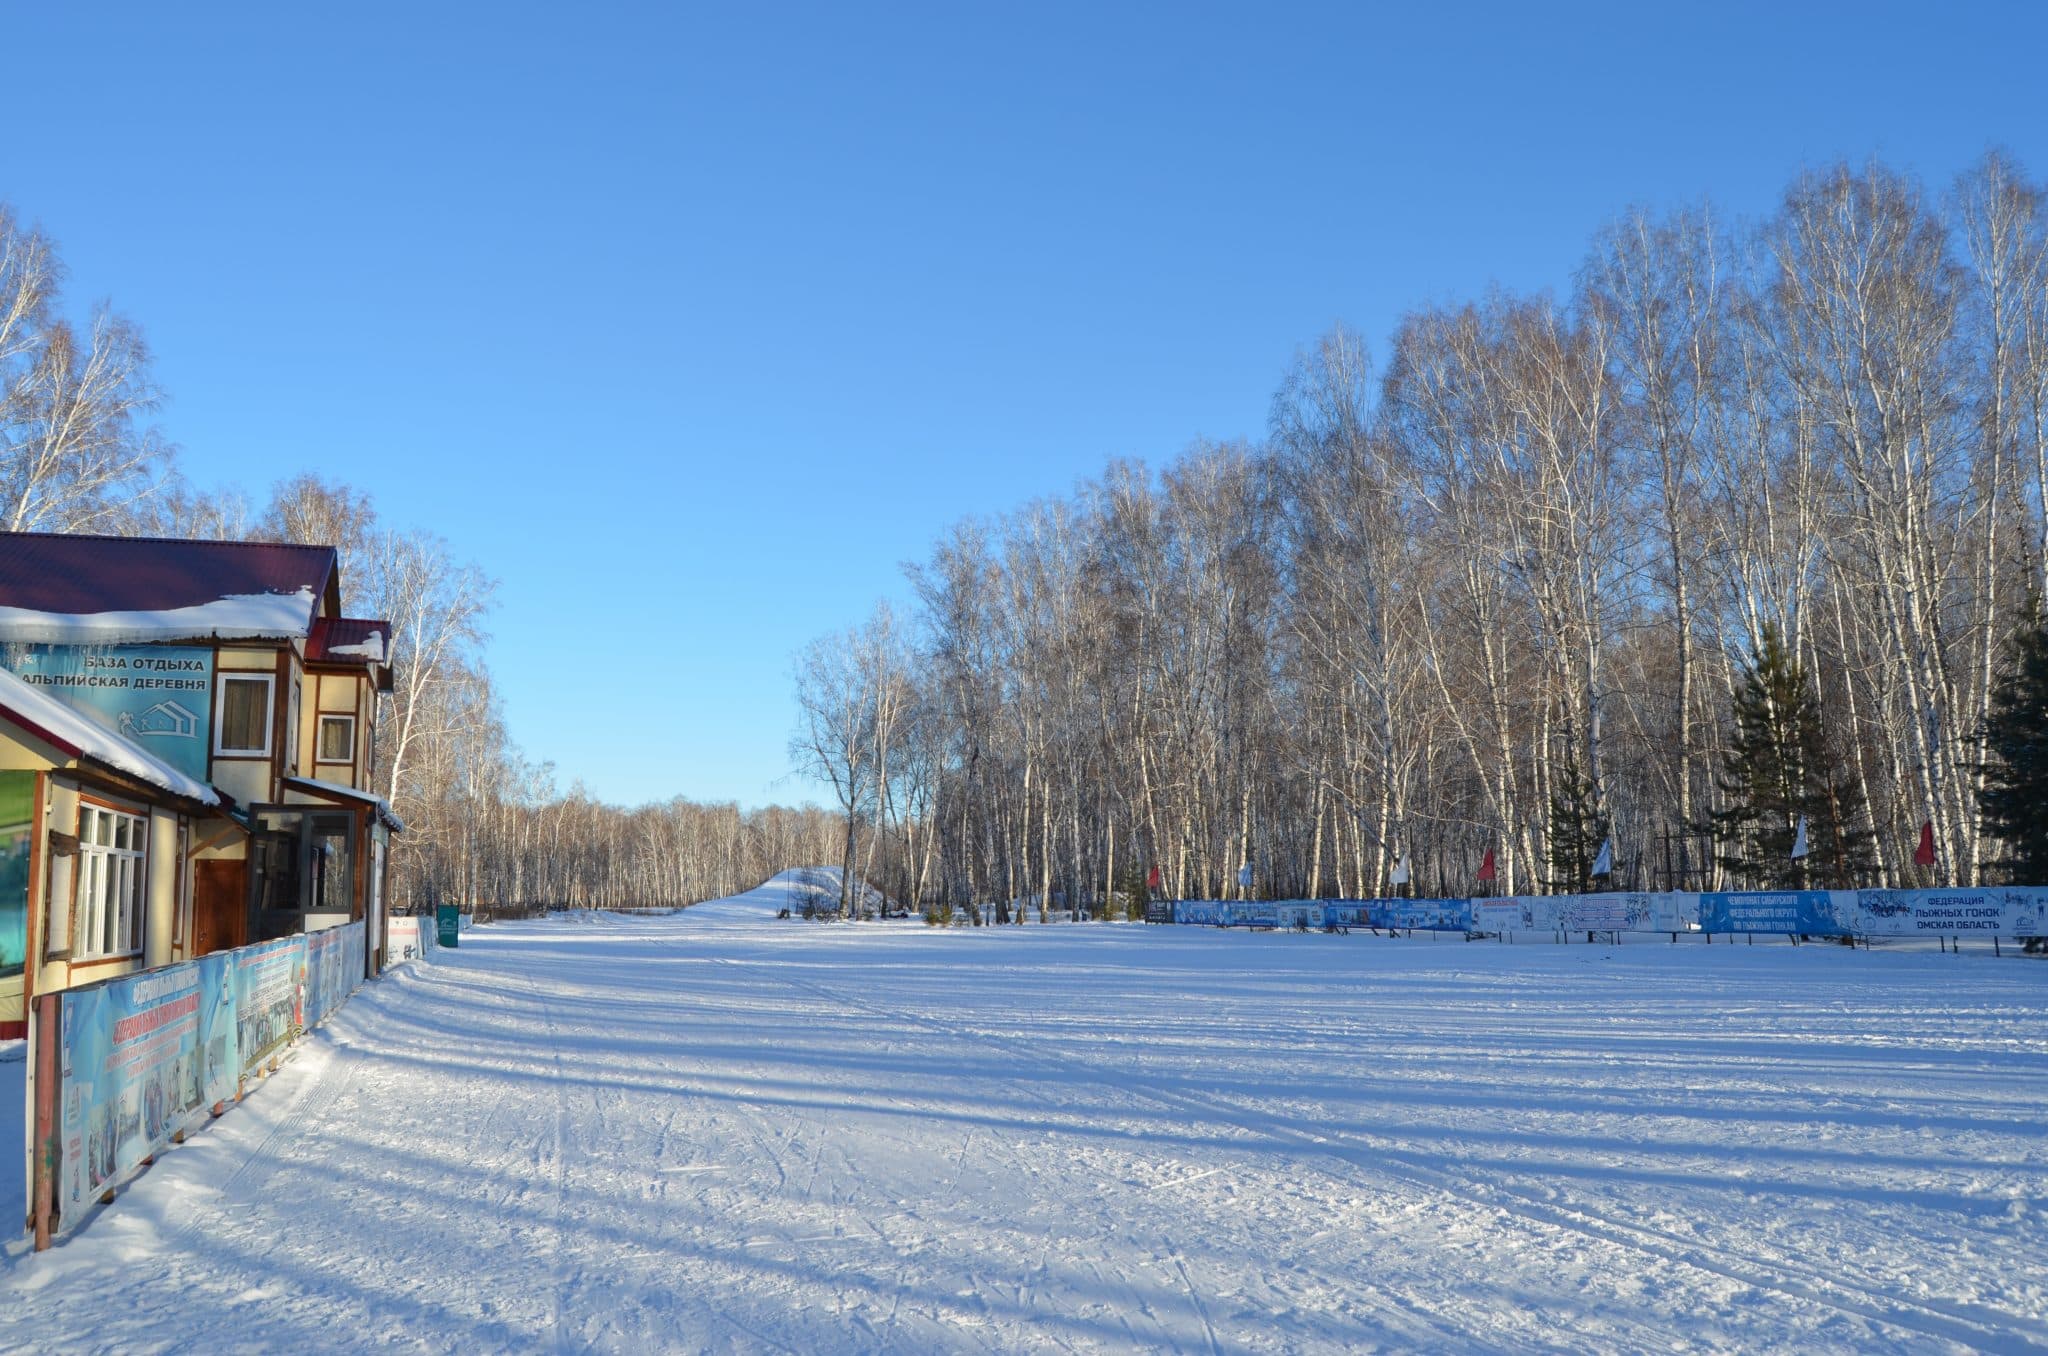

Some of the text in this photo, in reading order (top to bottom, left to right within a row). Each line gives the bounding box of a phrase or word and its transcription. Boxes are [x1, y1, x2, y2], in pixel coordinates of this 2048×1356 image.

[84, 656, 205, 672] БАЗА ОТДЫХА
[22, 674, 206, 690] АЛЬПИЙСКАЯ ДЕРЕВНЯ
[1927, 896, 1985, 906] ФЕДЕРАЦИЯ
[1915, 908, 2000, 918] ЛЫЖНЫХ ГОНОК
[1917, 920, 2000, 930] ОМСКАЯ ОБЛАСТЬ
